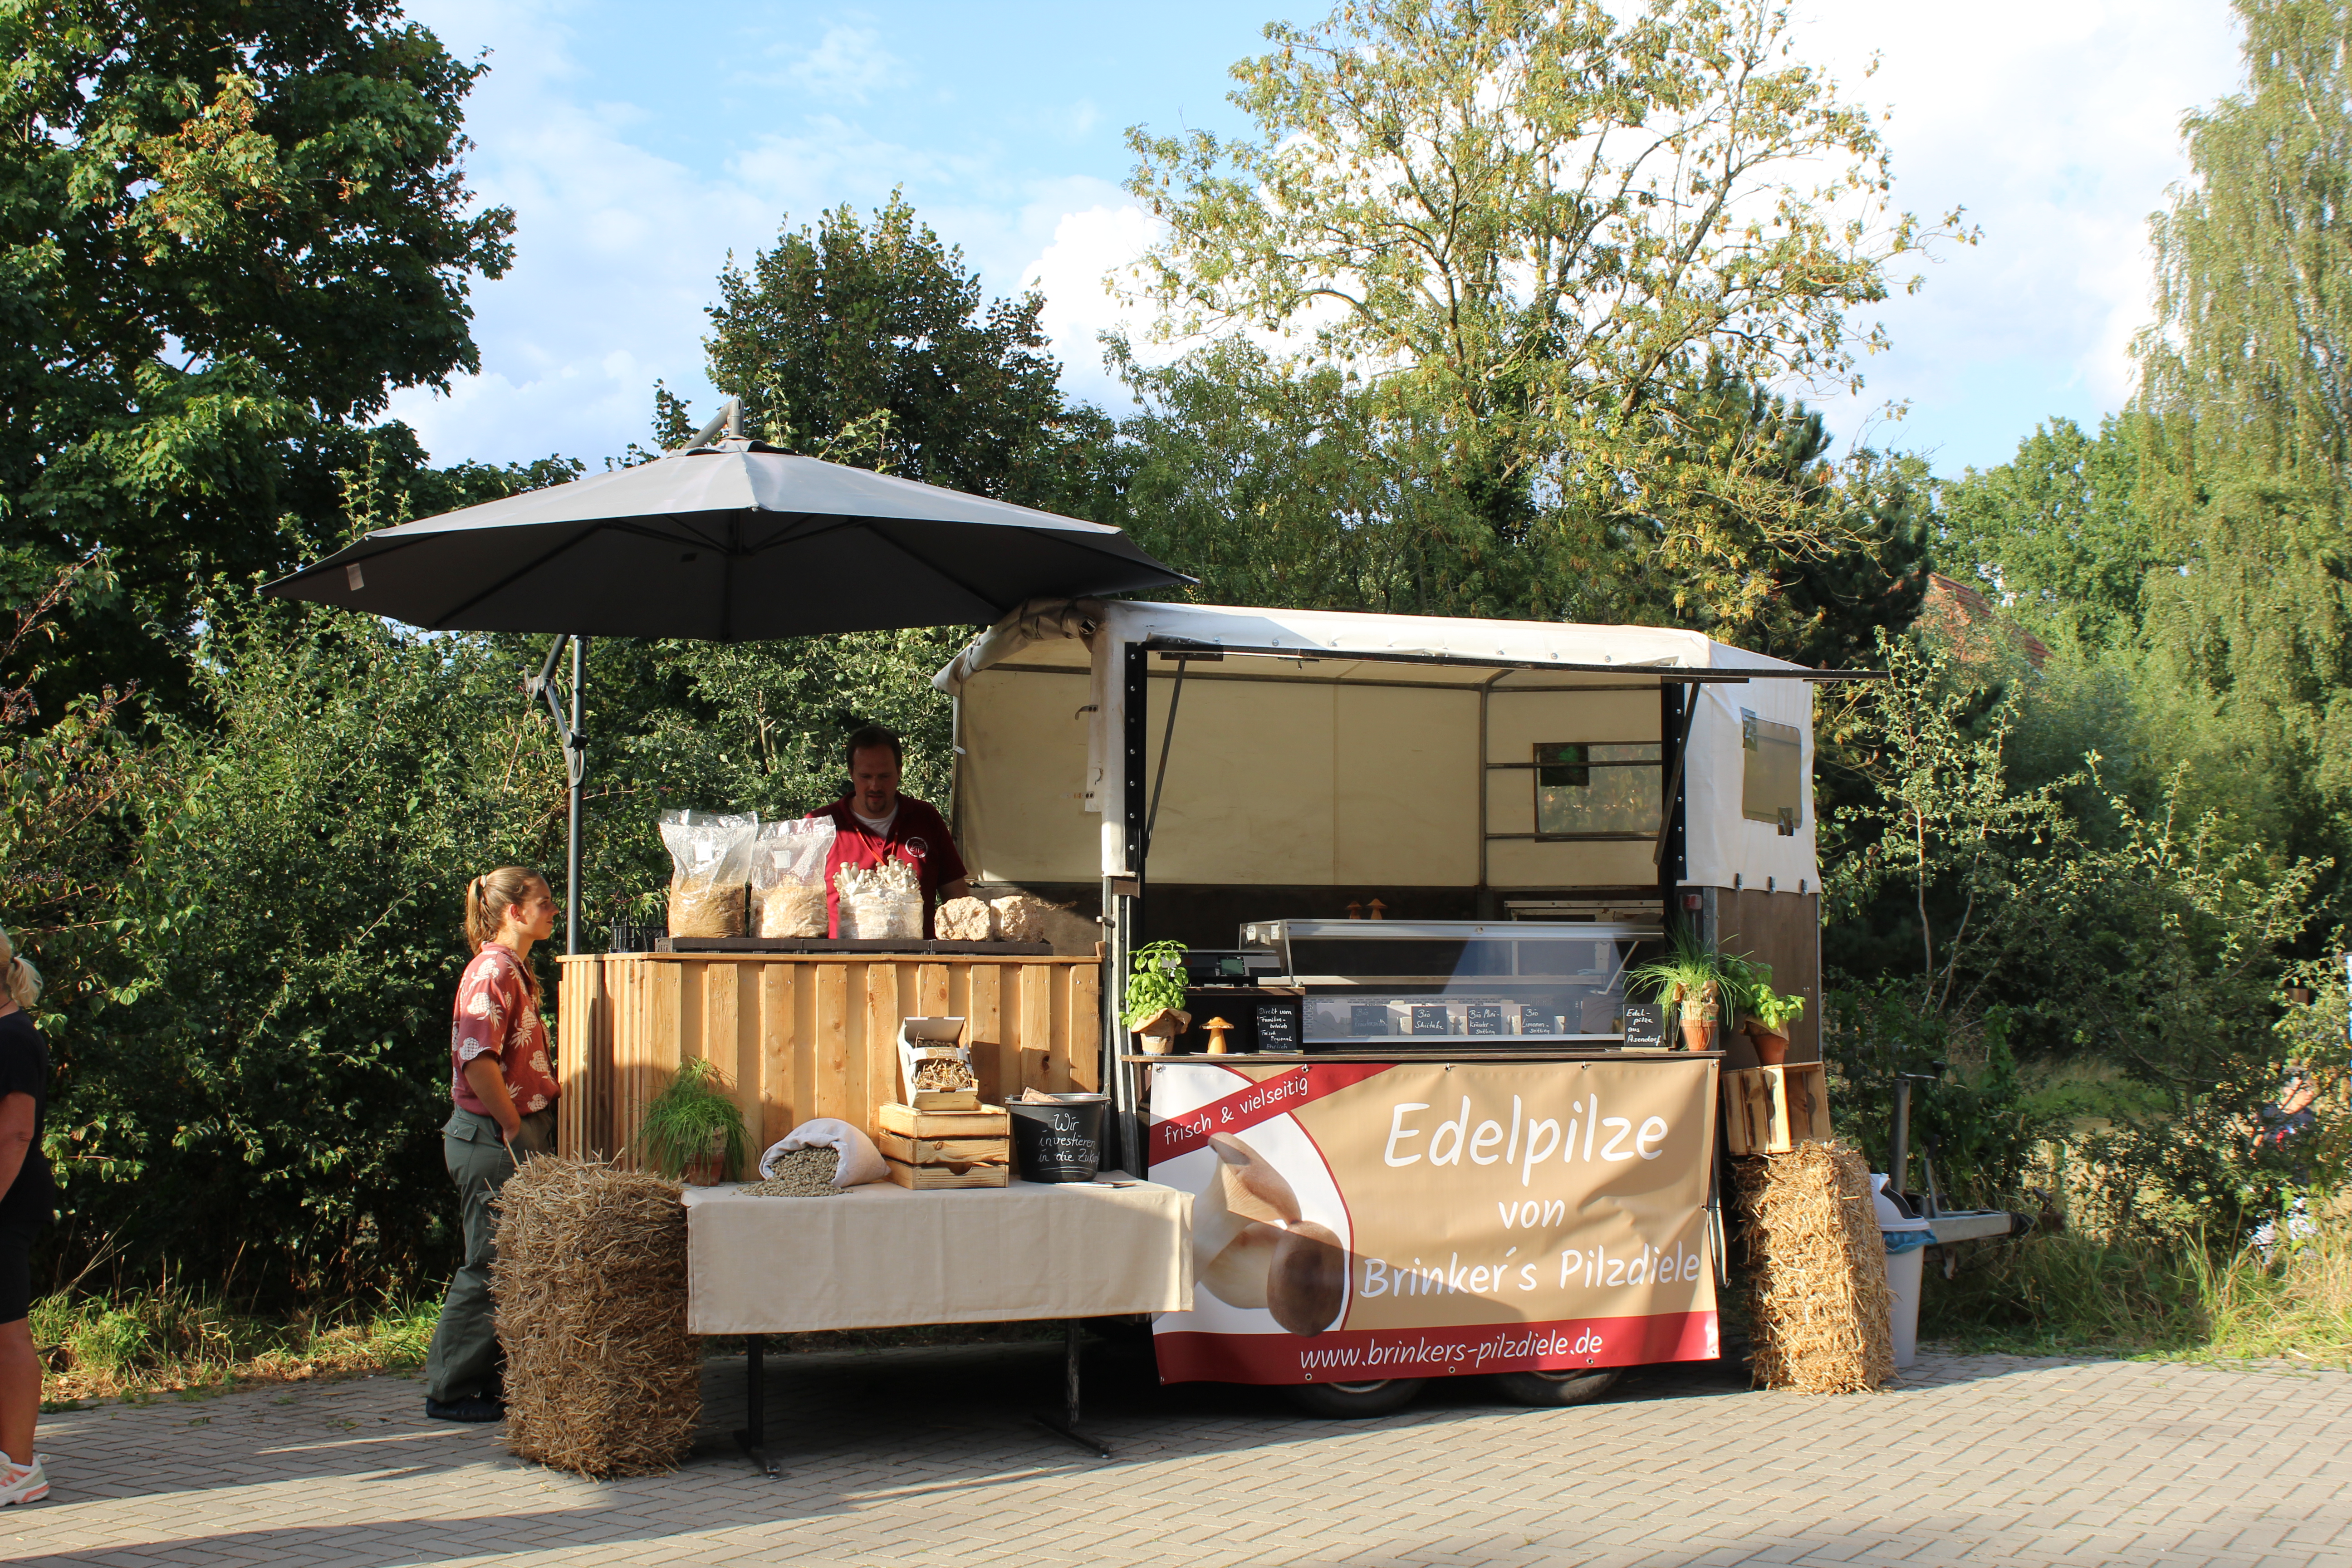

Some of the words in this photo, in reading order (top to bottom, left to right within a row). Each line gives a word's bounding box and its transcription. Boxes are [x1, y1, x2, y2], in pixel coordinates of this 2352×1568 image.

[1356, 1008, 1369, 1016] Bio
[1417, 1009, 1431, 1018] Bio
[1468, 1009, 1482, 1019] Bio
[1525, 1008, 1539, 1017] Bio
[1626, 1008, 1651, 1017] Edel-
[1632, 1017, 1654, 1025] pilze
[1627, 1034, 1661, 1047] Asendorf
[1164, 1113, 1212, 1145] frisch
[1221, 1106, 1235, 1124] &
[1239, 1076, 1308, 1115] vielseitig
[1053, 1113, 1079, 1132] Wir
[1038, 1130, 1096, 1150] investieren
[1384, 1093, 1668, 1187] Edelpilze
[1037, 1148, 1049, 1162] in
[1056, 1150, 1074, 1161] die
[1498, 1199, 1566, 1229] von
[1560, 1240, 1700, 1289] Pilzdiele
[1300, 1327, 1603, 1369] www.brinkers-pilzdiele.de
